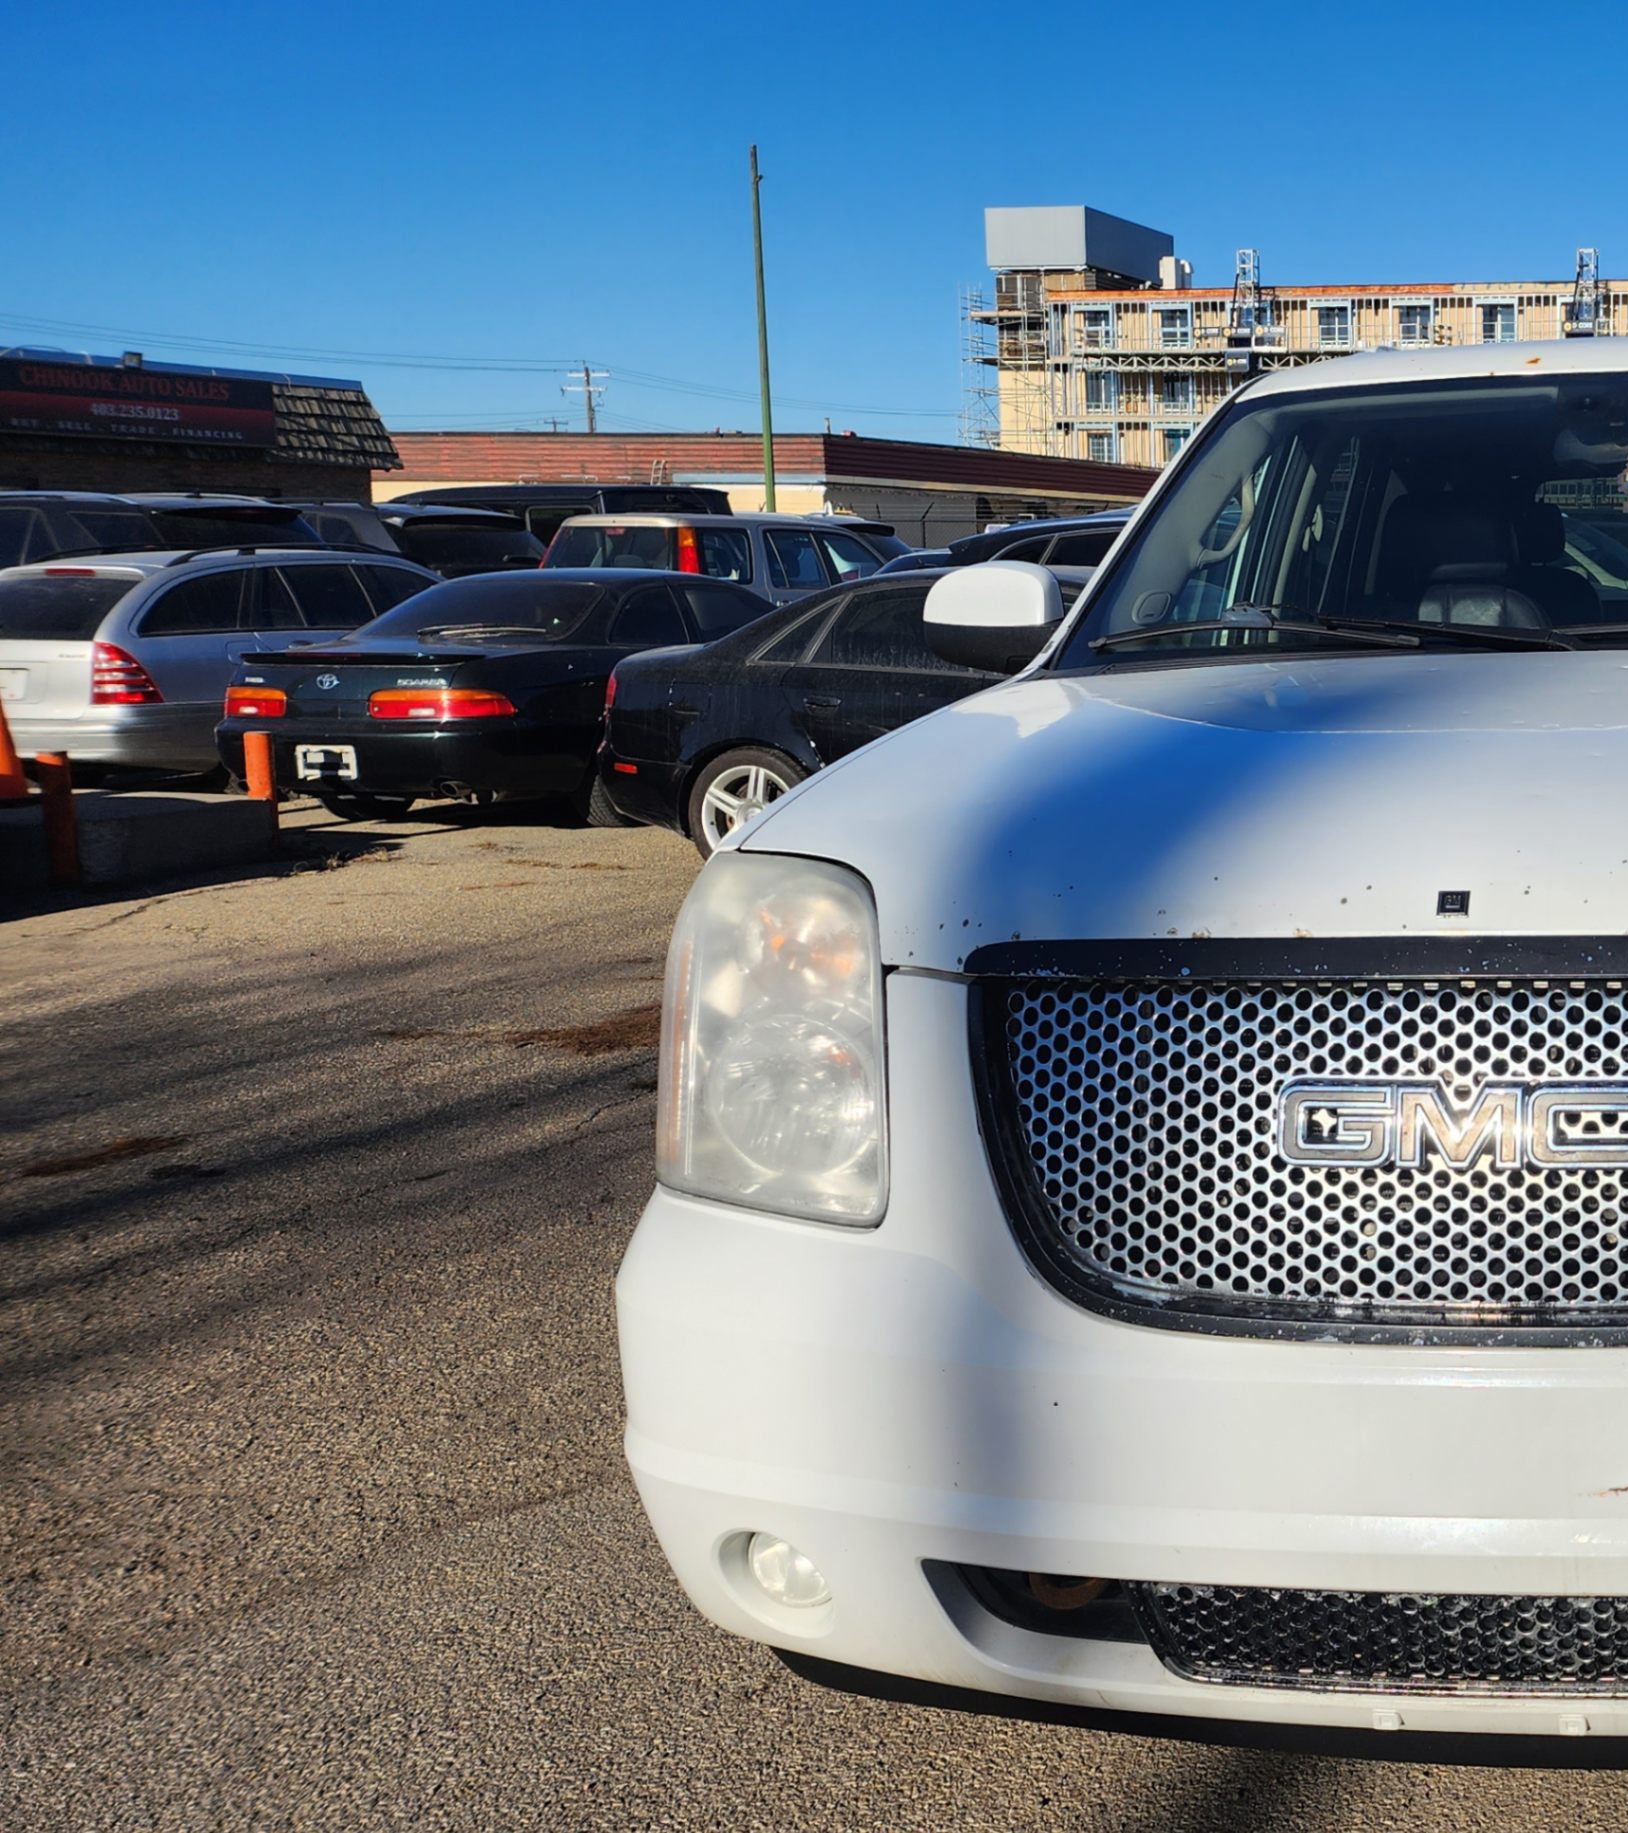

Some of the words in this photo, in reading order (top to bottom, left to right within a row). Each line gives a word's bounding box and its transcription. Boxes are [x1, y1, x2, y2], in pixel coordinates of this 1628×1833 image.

[18, 365, 113, 391] CHINOOK
[120, 373, 171, 396] AUTO
[176, 377, 229, 401] SALES
[111, 423, 155, 435] TRADE
[172, 427, 244, 440] FINANCING
